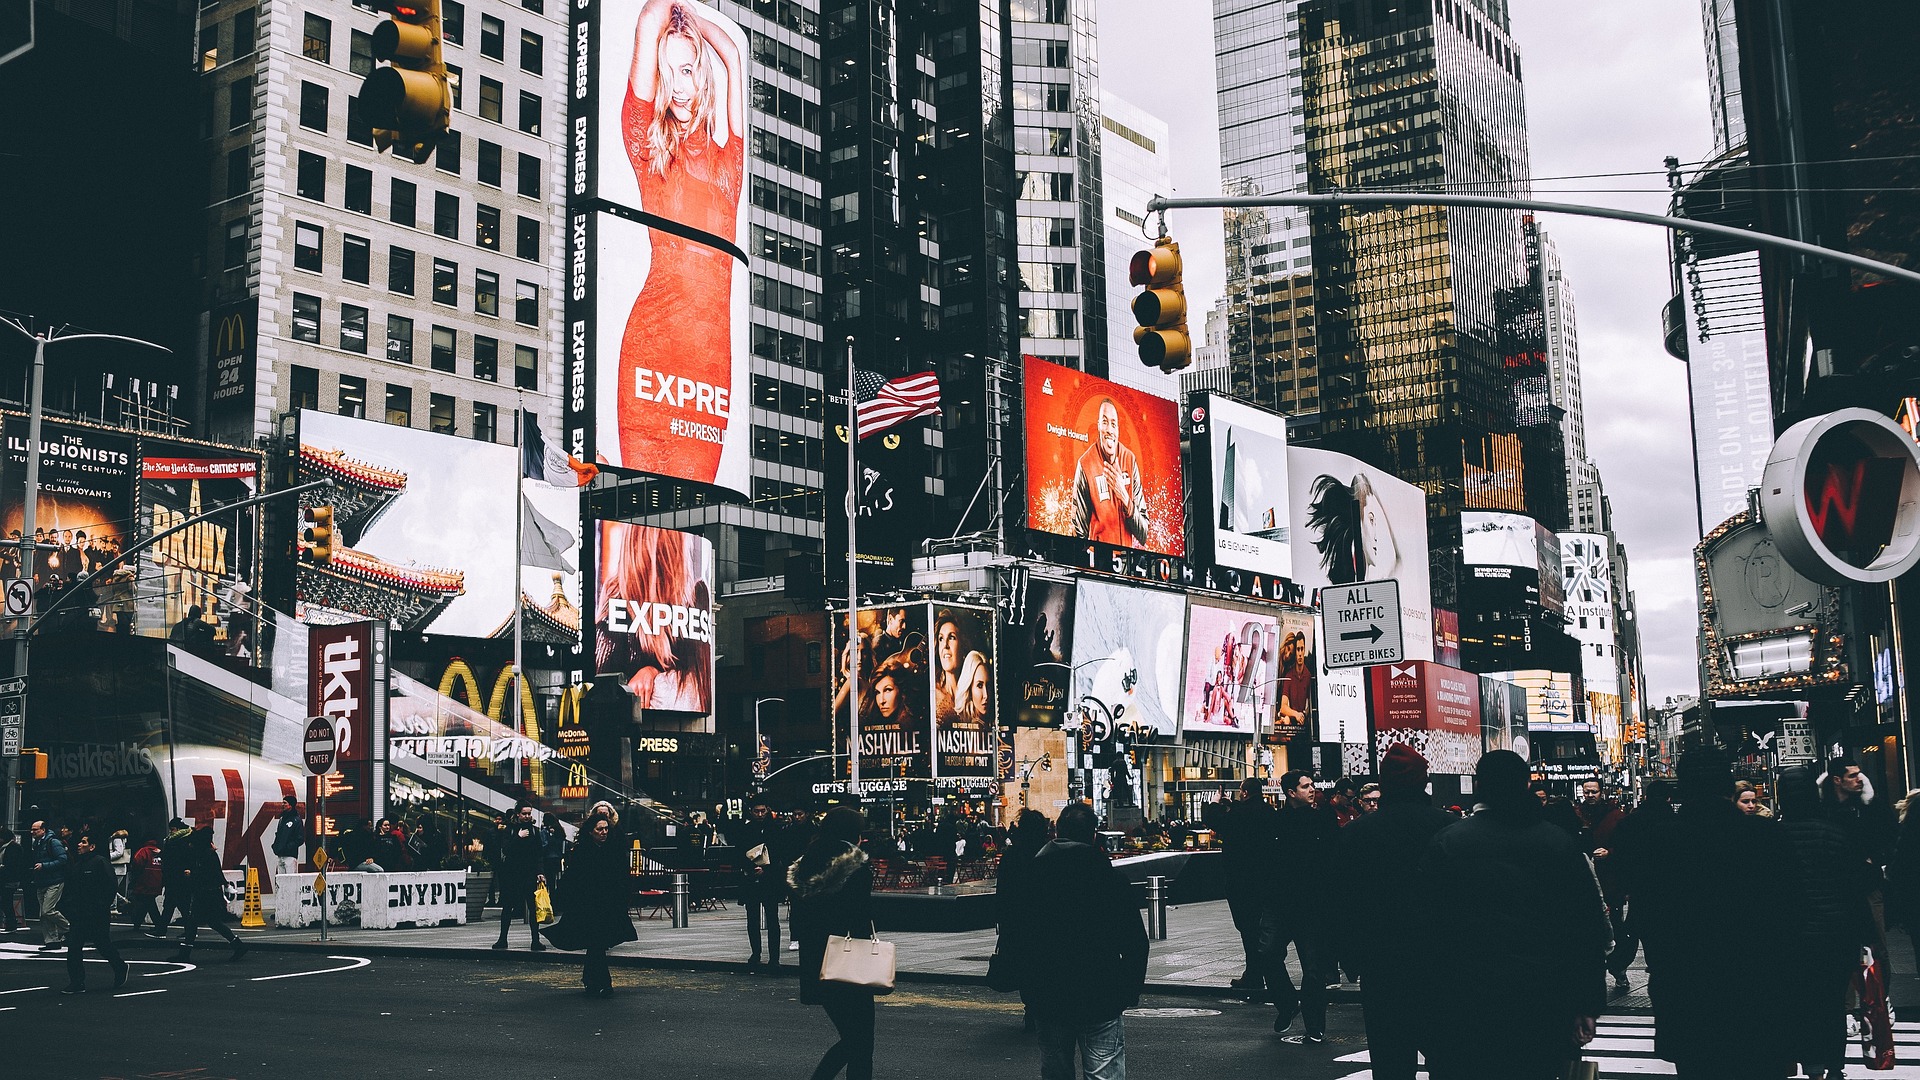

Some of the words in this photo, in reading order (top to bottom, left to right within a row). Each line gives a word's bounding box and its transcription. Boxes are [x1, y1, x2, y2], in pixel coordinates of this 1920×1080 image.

[575, 21, 588, 100] EXPRESS
[574, 116, 587, 195] EXPRESS
[573, 213, 586, 302] EXPRESS
[218, 354, 243, 369] OPEN
[572, 320, 585, 412] EXPRESS
[1712, 342, 1736, 372] 3RD
[220, 366, 239, 386] 24
[213, 384, 245, 400] HOURS
[634, 366, 729, 419] EXPRE
[1714, 378, 1740, 420] THE
[1046, 422, 1067, 438] Dwight
[1068, 428, 1088, 442] Howard
[1192, 424, 1205, 434] LG
[62, 435, 82, 446] THE
[1718, 426, 1742, 456] ON
[60, 461, 78, 470] THE
[142, 462, 155, 471] The
[156, 463, 170, 472] New
[171, 464, 188, 474] York
[188, 463, 208, 473] Times
[210, 463, 240, 474] CRITICS'
[240, 462, 256, 472] PICK
[24, 480, 42, 490] TE
[45, 484, 112, 498] CLAIRVOYANTS
[189, 478, 202, 515] A
[152, 503, 228, 576] BRONX
[1218, 538, 1226, 548] LG
[846, 552, 894, 562] CSBROADWAY.COM
[1086, 546, 1170, 582] 1540
[1347, 588, 1373, 604] ALL
[1338, 606, 1384, 622] TRAFFIC
[1402, 606, 1426, 622] supersonic
[1524, 619, 1532, 651] 1500
[1332, 652, 1366, 664] EXCEPT
[1369, 648, 1396, 660] BIKES
[2, 684, 10, 692] ONE
[14, 682, 23, 690] WAY
[324, 635, 360, 754] tkts
[1328, 682, 1346, 696] VISIT
[1348, 684, 1357, 698] US
[10, 716, 20, 724] LANE
[309, 729, 319, 738] DO
[319, 728, 330, 737] NOT
[938, 730, 994, 754] NASHVILLE
[846, 730, 921, 756] NASHVILLE
[310, 754, 329, 764] ENTER
[975, 756, 988, 766] CMT
[1184, 740, 1246, 768] FOREVER
[812, 783, 845, 794] GIFTS
[857, 780, 908, 792] UGGAGE
[936, 778, 956, 788] GIFTS
[312, 882, 362, 907] YP
[400, 882, 456, 908] NYPD
